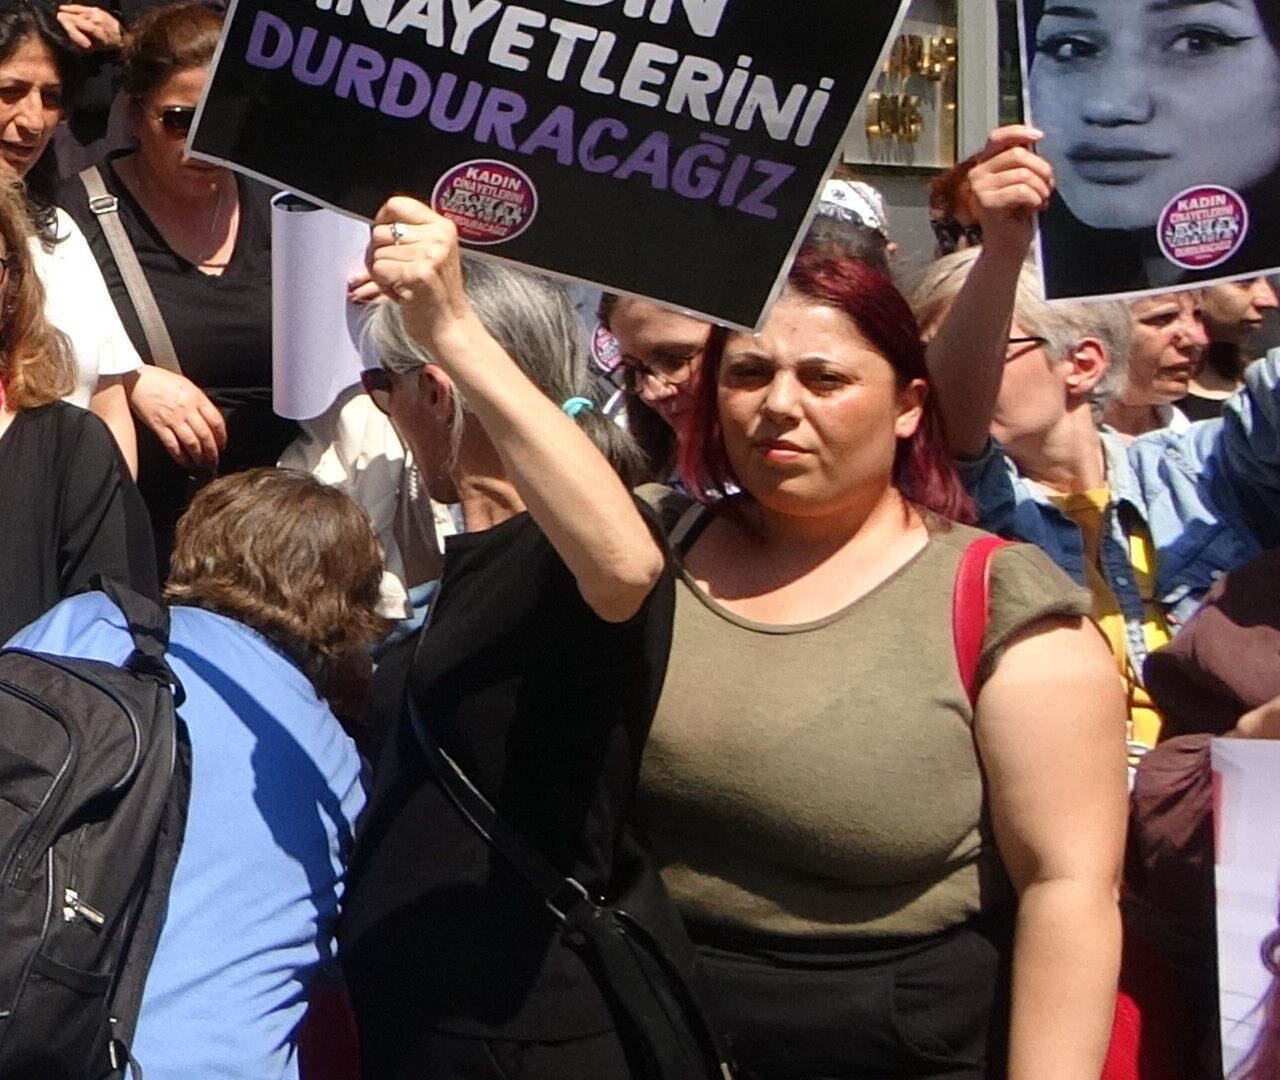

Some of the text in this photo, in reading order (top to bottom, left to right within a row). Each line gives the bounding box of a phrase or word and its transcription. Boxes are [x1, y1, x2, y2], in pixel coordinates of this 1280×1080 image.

[245, 10, 796, 220] DURDURACAĞIZ
[465, 167, 522, 191] KADIN
[1177, 194, 1227, 211] KADIN
